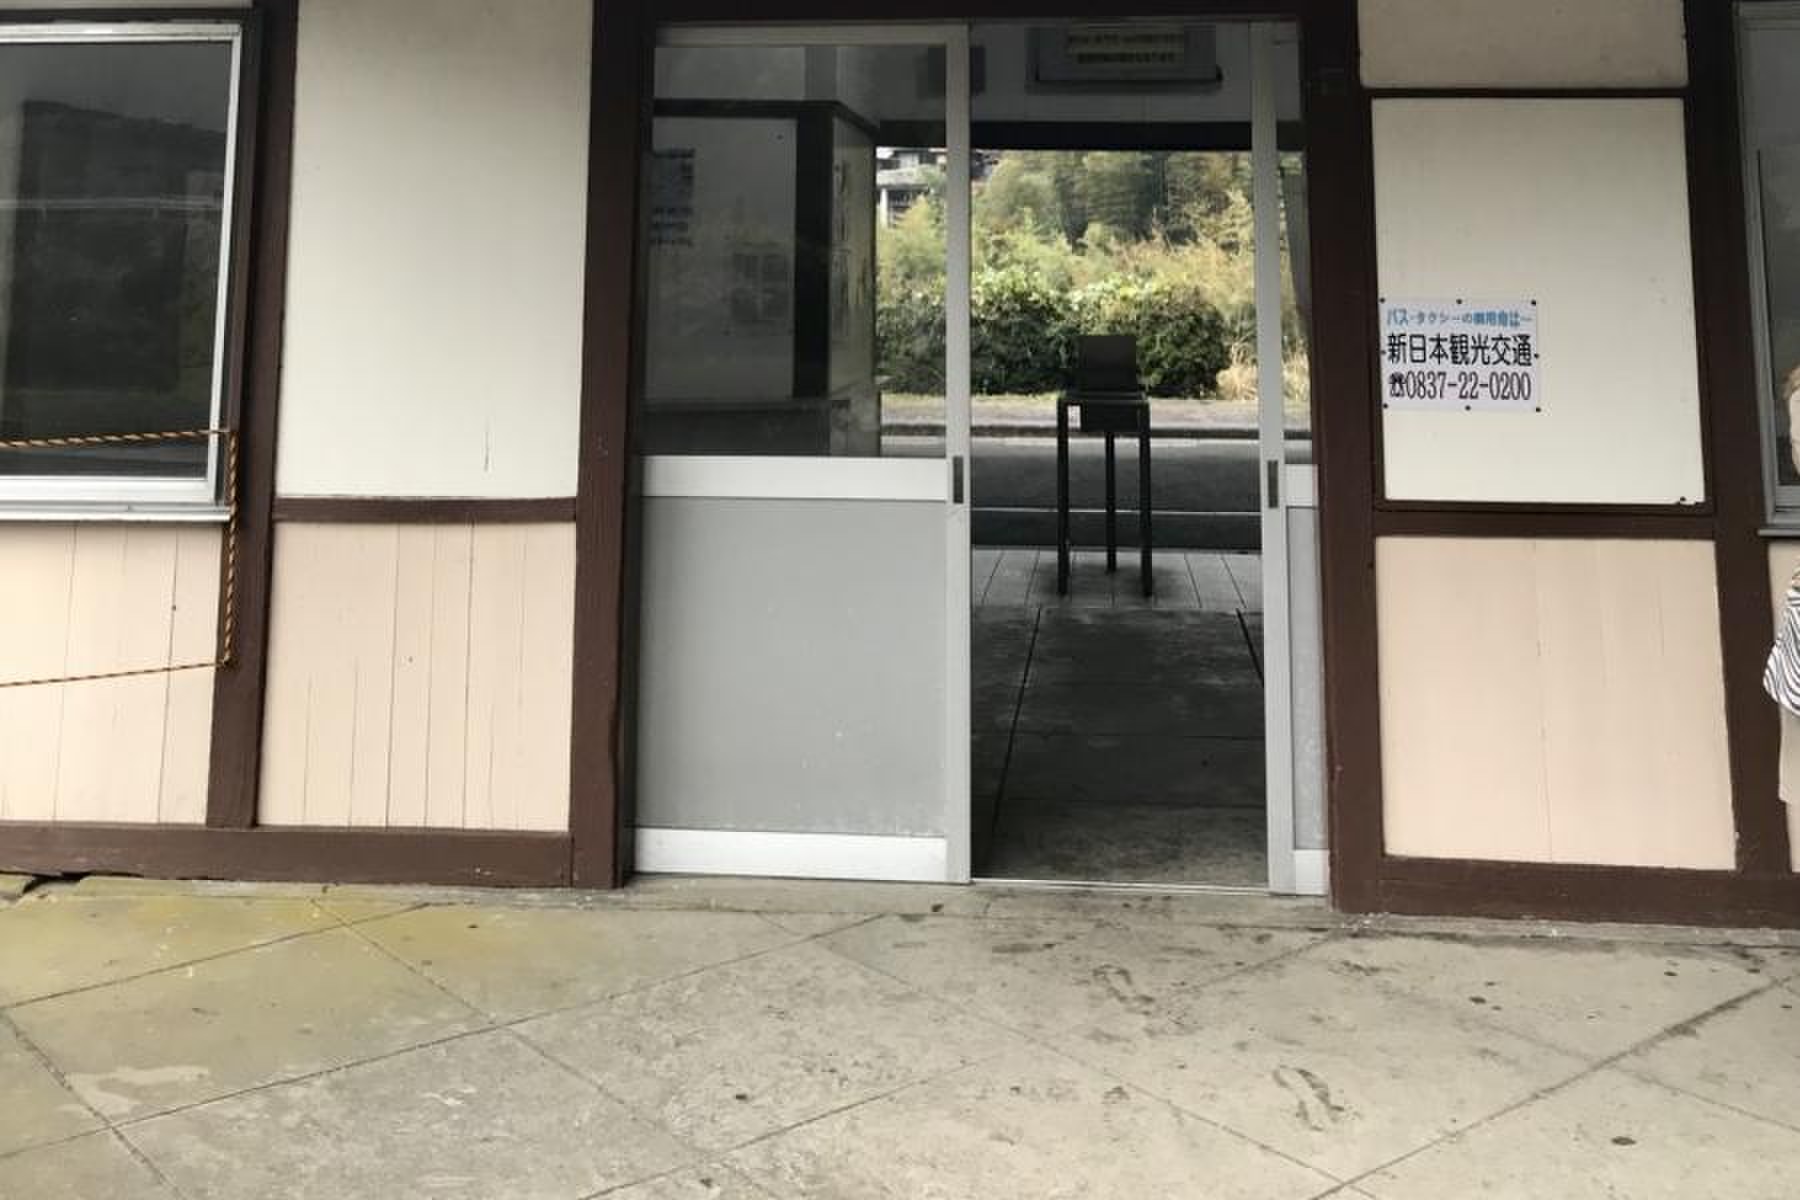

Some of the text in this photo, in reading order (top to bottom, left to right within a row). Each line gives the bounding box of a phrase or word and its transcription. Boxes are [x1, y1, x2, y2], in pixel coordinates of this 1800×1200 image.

[1387, 332, 1532, 366] 新日本観光交通
[1405, 371, 1532, 400] 0837-22-0200
